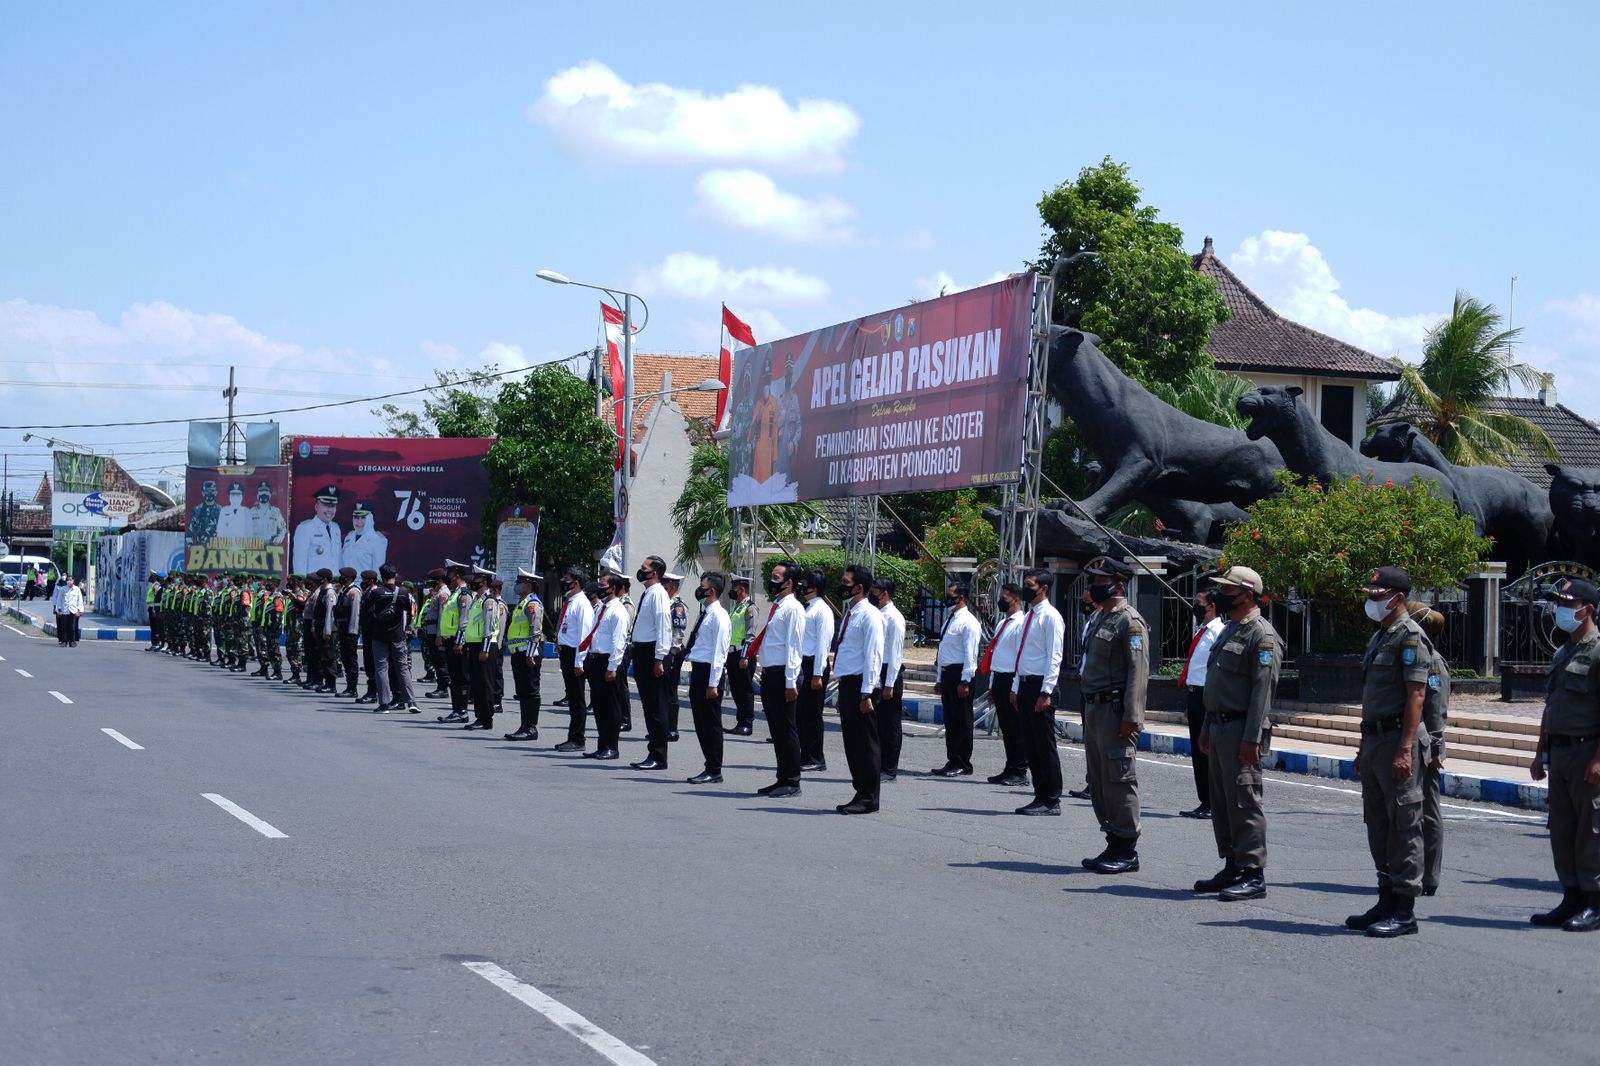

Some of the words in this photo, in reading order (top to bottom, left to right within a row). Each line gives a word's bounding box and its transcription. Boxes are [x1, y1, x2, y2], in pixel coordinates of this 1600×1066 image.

[810, 363, 846, 408] APEL
[850, 351, 904, 401] GELAR
[907, 328, 1001, 391] PASUKAN
[815, 426, 877, 458] PEMINDAHAN
[880, 421, 921, 449] ISOMAN
[924, 417, 939, 444] KE
[942, 411, 983, 441] ISOTER
[829, 462, 839, 485] DI
[840, 454, 897, 484] KABUPATEN
[901, 446, 961, 478] PONOROGO
[187, 545, 284, 571] BANGKIT
